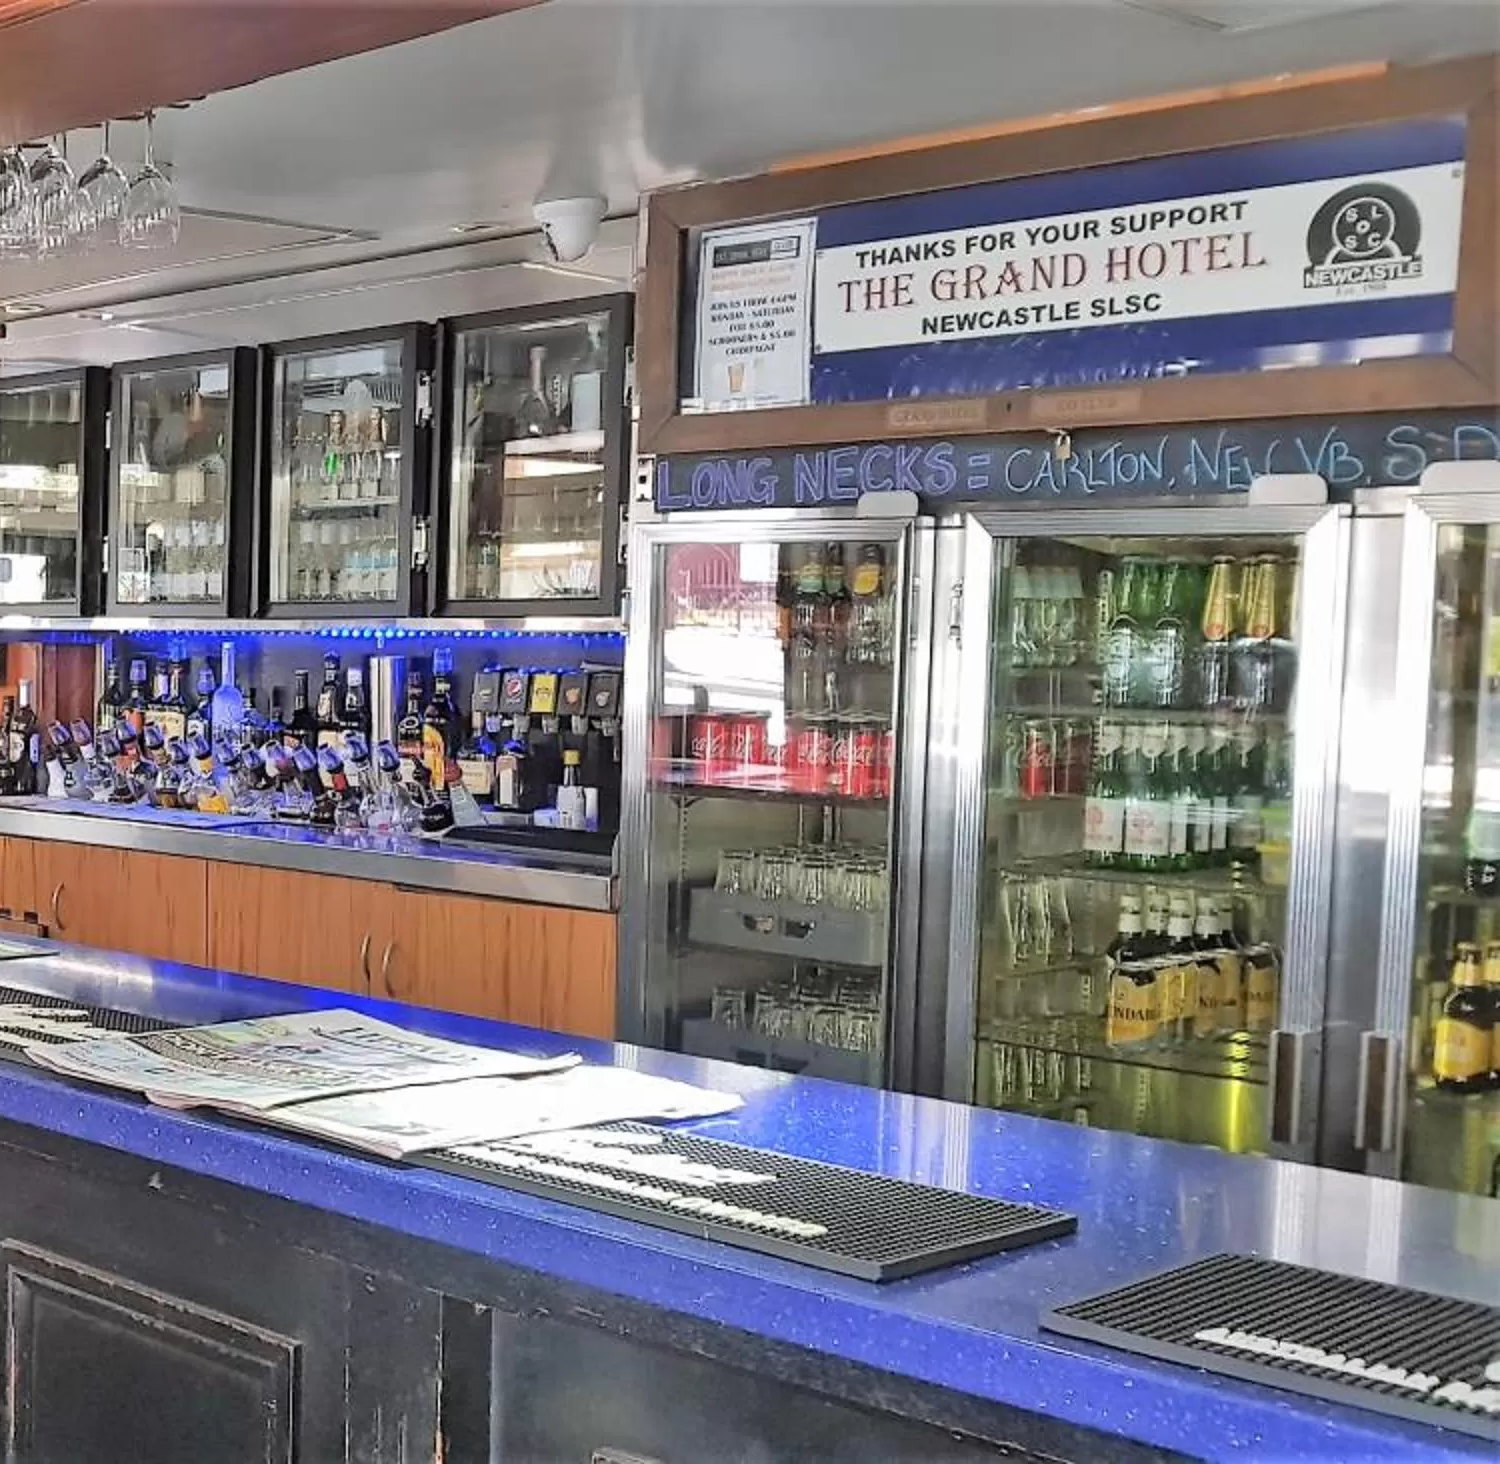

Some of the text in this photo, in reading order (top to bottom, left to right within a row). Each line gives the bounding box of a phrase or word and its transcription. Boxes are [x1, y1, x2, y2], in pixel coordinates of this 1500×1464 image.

[856, 200, 1249, 269] THANKS FOR YOUR SUPPORT
[838, 273, 914, 313] THE
[930, 252, 1088, 302] GRAND
[1104, 230, 1268, 283] HOTEL
[1304, 260, 1424, 288] NEWCASTLE
[921, 292, 1163, 336] NEWCASTLE SLSC
[656, 457, 779, 509] LONG
[794, 443, 957, 504] NECKS
